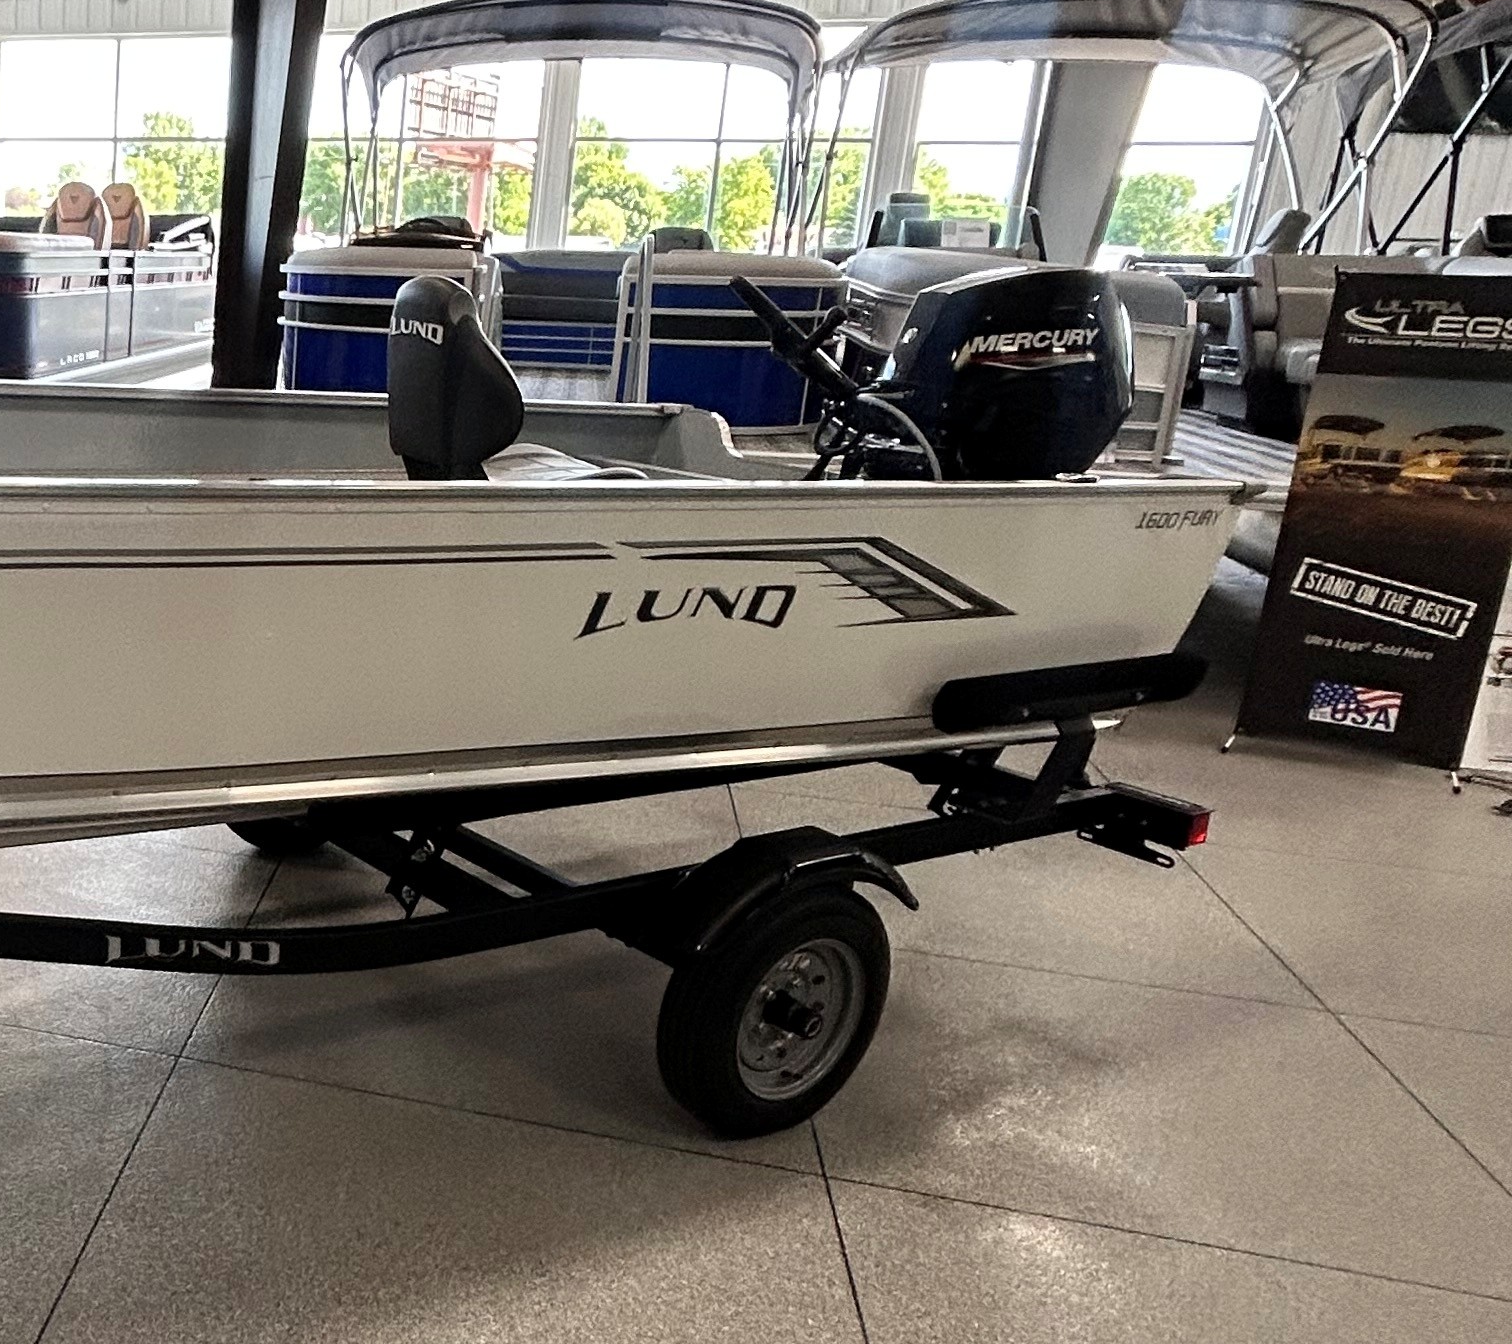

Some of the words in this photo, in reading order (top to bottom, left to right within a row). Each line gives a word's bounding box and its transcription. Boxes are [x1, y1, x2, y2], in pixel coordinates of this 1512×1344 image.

[1374, 299, 1466, 315] ULTRA
[390, 316, 444, 345] LUND
[970, 327, 1101, 354] MERCURY
[1135, 511, 1180, 529] 1600
[573, 585, 797, 640] LUND
[1304, 570, 1356, 599] STAND
[1354, 584, 1380, 606] ON
[1379, 590, 1413, 615] THE
[1410, 598, 1462, 629] BEST!
[1331, 702, 1391, 730] USA
[105, 935, 280, 965] LUND
